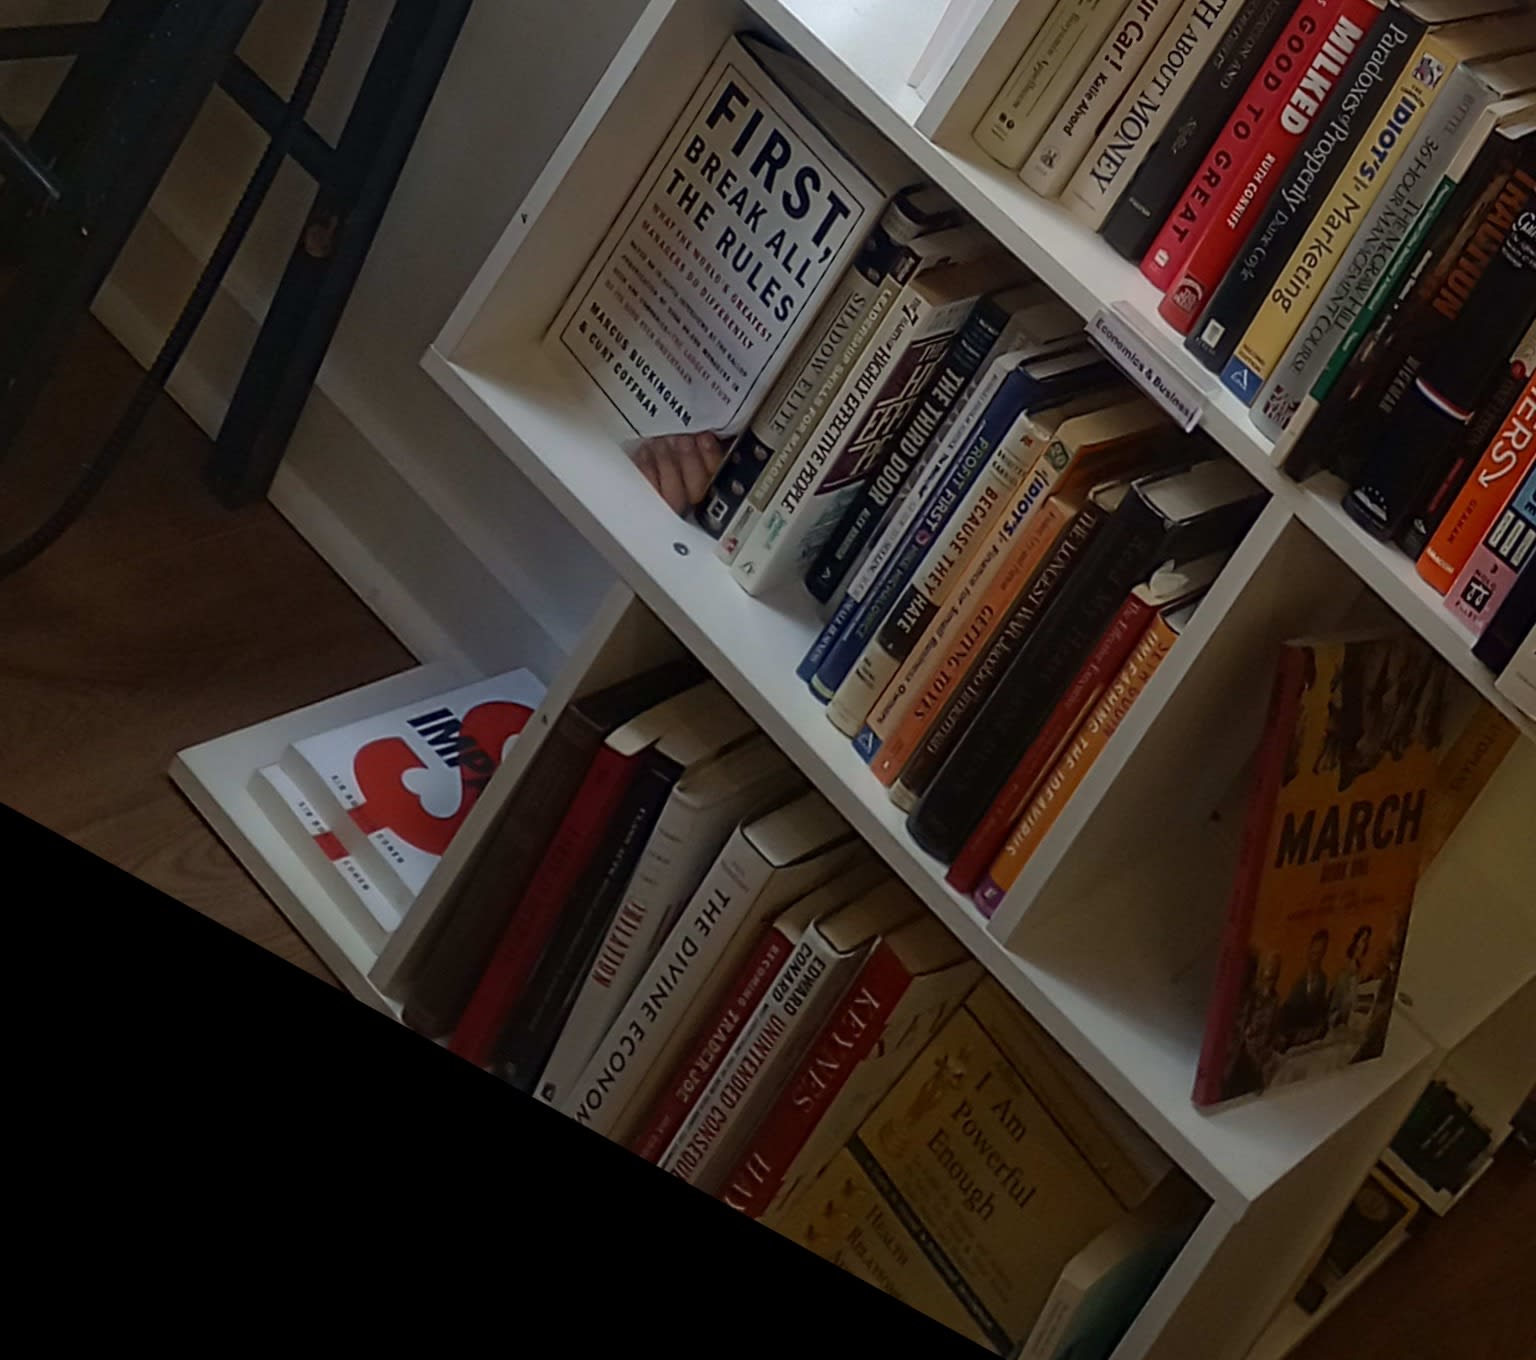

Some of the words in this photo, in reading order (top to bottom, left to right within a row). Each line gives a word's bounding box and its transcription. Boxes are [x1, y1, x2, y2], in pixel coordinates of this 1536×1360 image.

[1147, 24, 1201, 95] ABOUT
[1260, 13, 1317, 94] GOOD
[1276, 14, 1362, 137] MILKED
[1338, 22, 1407, 117] Paradoxes
[1060, 99, 1090, 137] Alvord
[1083, 91, 1160, 195] MONEY
[1229, 101, 1263, 142] TO
[1417, 136, 1439, 161] 36
[703, 80, 854, 263] FIRST,
[1167, 148, 1233, 243] GREAT
[1252, 153, 1276, 183] RUTH
[1276, 120, 1348, 213] Prosperity
[1387, 157, 1425, 207] HOUR
[682, 133, 767, 233] BREAK
[763, 225, 816, 288] ALL
[1224, 181, 1258, 229] CONNIFF
[651, 203, 676, 230] WHAT
[730, 293, 772, 343] GREATEST
[662, 167, 715, 231] THE
[714, 225, 796, 324] RULES
[1269, 192, 1360, 314] Marketing
[685, 271, 700, 288] DO
[698, 287, 755, 351] DIFFERENTLY
[808, 292, 865, 373] SHADOW
[835, 287, 891, 365] LEADERSHIP
[578, 320, 588, 334] &
[587, 332, 614, 364] CURT
[613, 362, 658, 418] COFFMAN
[589, 302, 630, 351] MARCUS
[628, 348, 692, 428] BUCKINGHAM
[810, 364, 843, 406] SKILLS
[851, 347, 890, 398] HIGHLY
[928, 367, 963, 405] THE
[769, 378, 812, 434] ELITE
[793, 406, 817, 434] FOR
[809, 393, 860, 464] EFFECTIVE
[894, 401, 941, 459] THIRD
[779, 461, 818, 512] PEOPLE
[865, 453, 909, 506] DOOR
[949, 435, 990, 490] PROFIT
[922, 488, 957, 532] FIRST
[948, 486, 997, 554] BECAUSE
[854, 568, 904, 638] MICHALOWICZ
[921, 554, 954, 596] THEY
[1024, 538, 1077, 608] LONGEST
[894, 593, 928, 633] HATE
[944, 604, 994, 669] GETTING
[1002, 605, 1034, 641] WAR
[925, 683, 978, 755] Timerman
[1277, 790, 1424, 868] MARCH
[690, 888, 729, 936] THE
[638, 936, 699, 1022] DIVINE
[735, 944, 779, 1007] BECOMING
[769, 942, 812, 1002] CONARD
[781, 956, 825, 1016] EDWARD
[692, 1008, 739, 1072] TRADER
[717, 1014, 786, 1108] UNINTENDED
[789, 987, 880, 1113] KEYNES
[673, 1067, 702, 1103] JOE
[990, 1093, 1029, 1143] Am
[927, 1128, 1000, 1222] Enough
[950, 1098, 1036, 1209] Powerful
